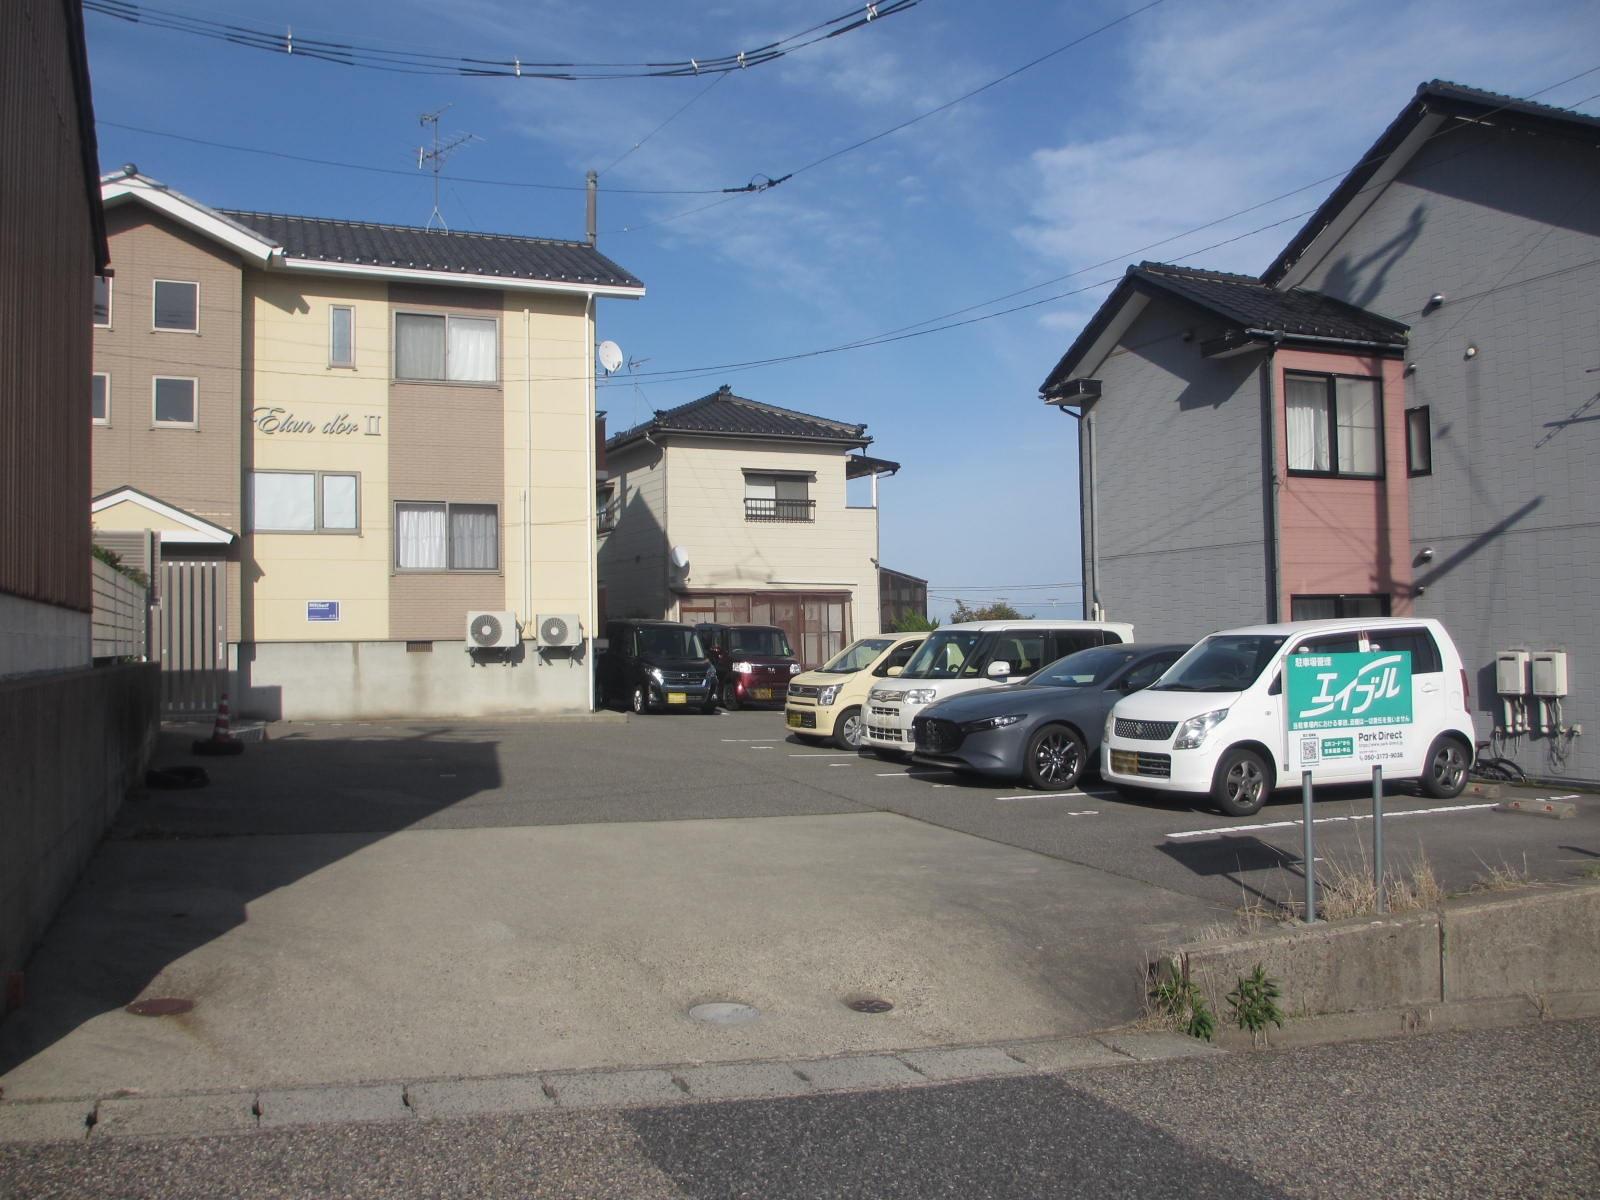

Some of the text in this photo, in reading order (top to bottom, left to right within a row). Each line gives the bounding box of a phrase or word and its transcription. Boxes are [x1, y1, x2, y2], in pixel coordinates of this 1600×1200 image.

[251, 407, 316, 435] Elan
[1300, 655, 1402, 718] エイブル
[1358, 731, 1403, 742] Park Direct
